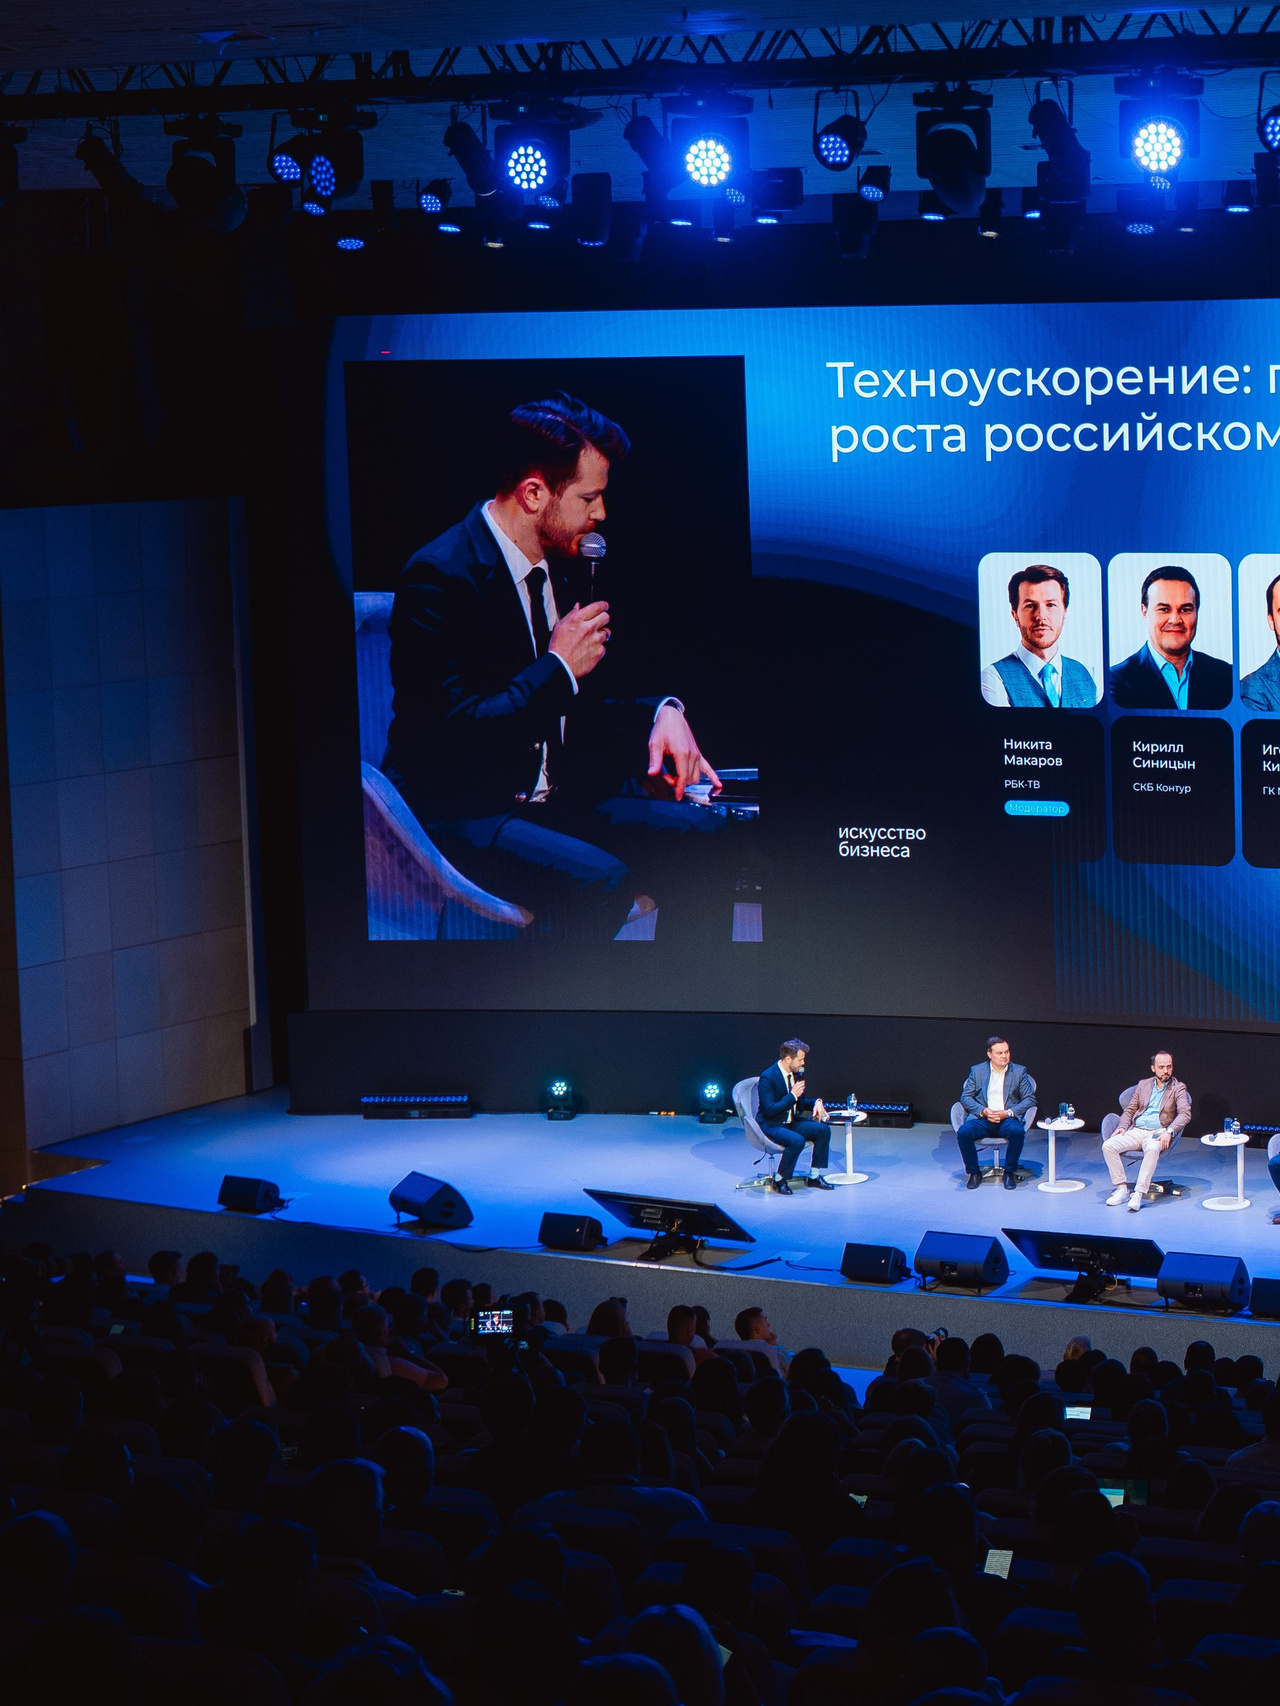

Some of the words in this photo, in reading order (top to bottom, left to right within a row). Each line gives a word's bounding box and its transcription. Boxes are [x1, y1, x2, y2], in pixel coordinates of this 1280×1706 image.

[826, 361, 1251, 406] Техноускорение:
[831, 425, 966, 463] роста
[1004, 739, 1052, 750] Никита
[1133, 740, 1183, 754] Кирилл
[1005, 755, 1062, 768] Макаров
[1133, 757, 1195, 770] Синицын
[1005, 780, 1040, 788] РБК-ТВ
[1133, 783, 1154, 791] СКБ
[1156, 784, 1191, 794] Контур
[1263, 787, 1275, 795] ГК
[1009, 803, 1065, 815] Модератор
[839, 827, 926, 843] искусство
[839, 841, 910, 857] бизнеса
